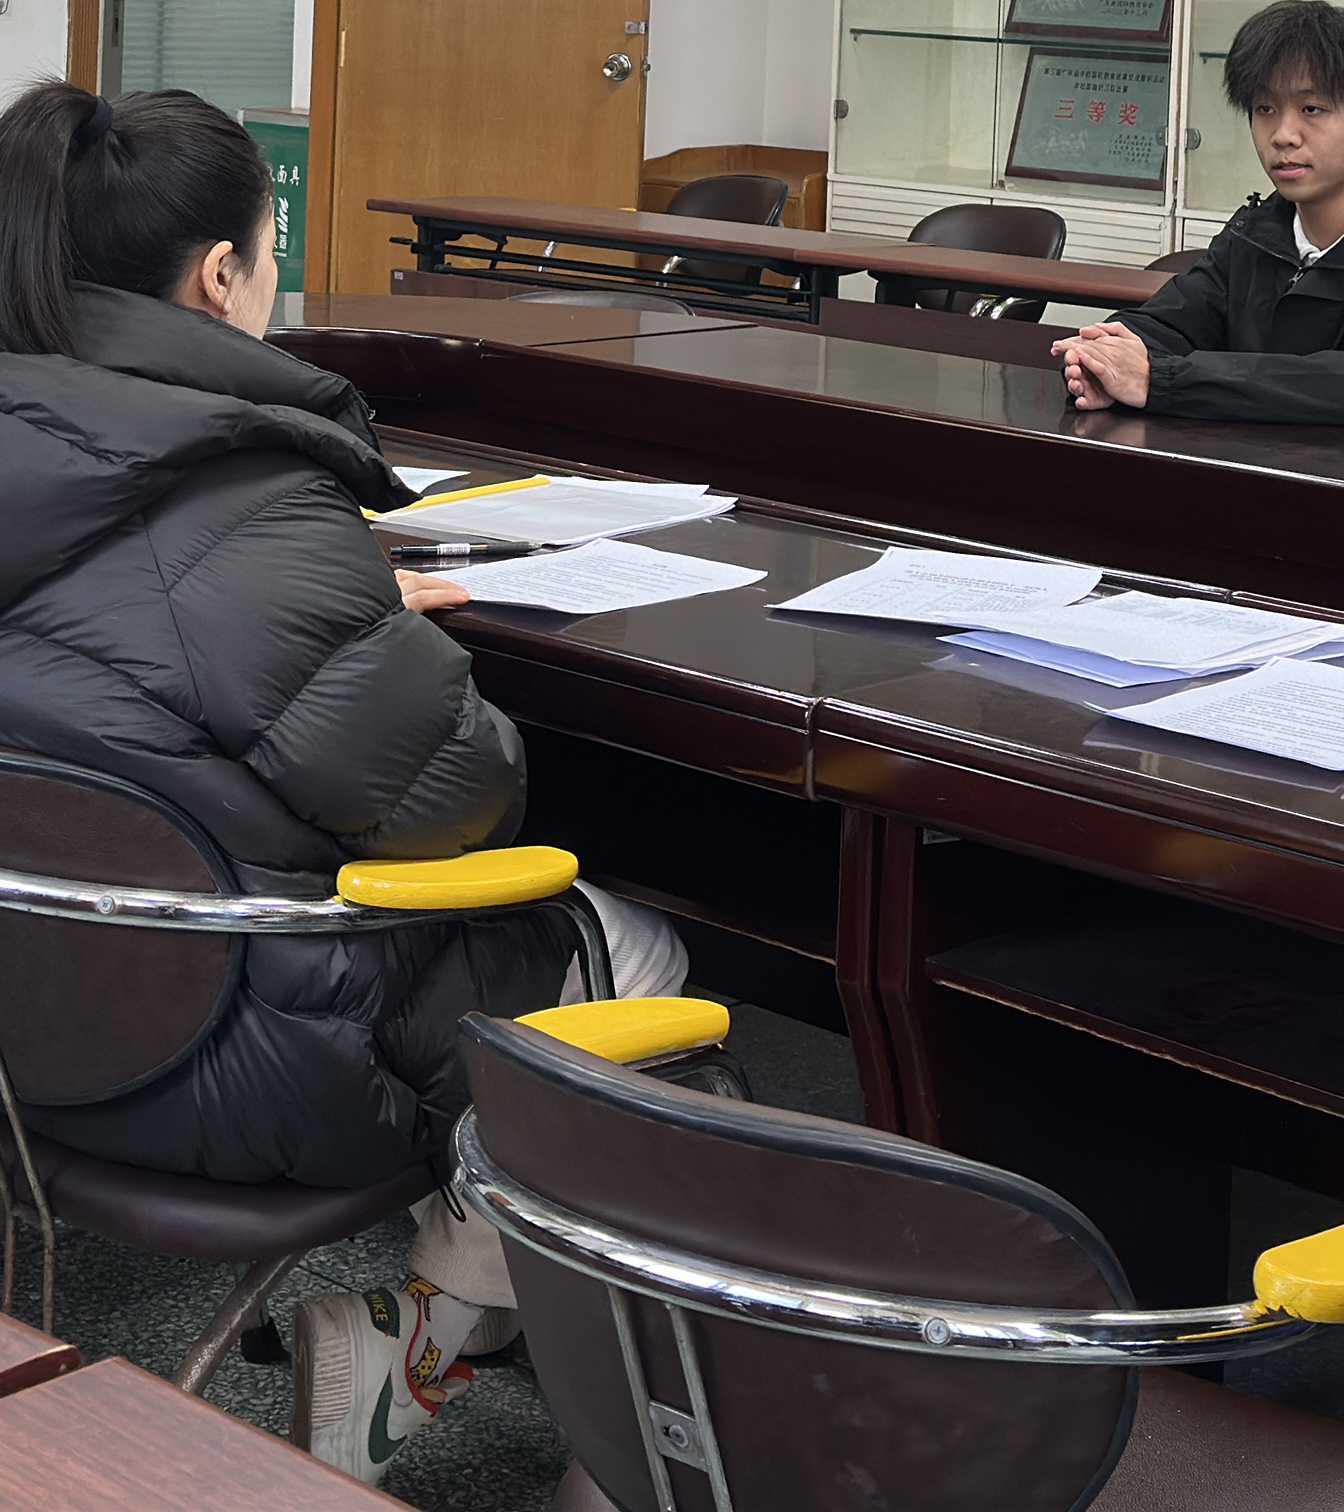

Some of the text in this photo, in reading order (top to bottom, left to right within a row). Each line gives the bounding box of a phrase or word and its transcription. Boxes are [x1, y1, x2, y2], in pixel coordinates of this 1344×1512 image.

[1054, 99, 1140, 127] 三等奖
[368, 1293, 389, 1322] NIKE
